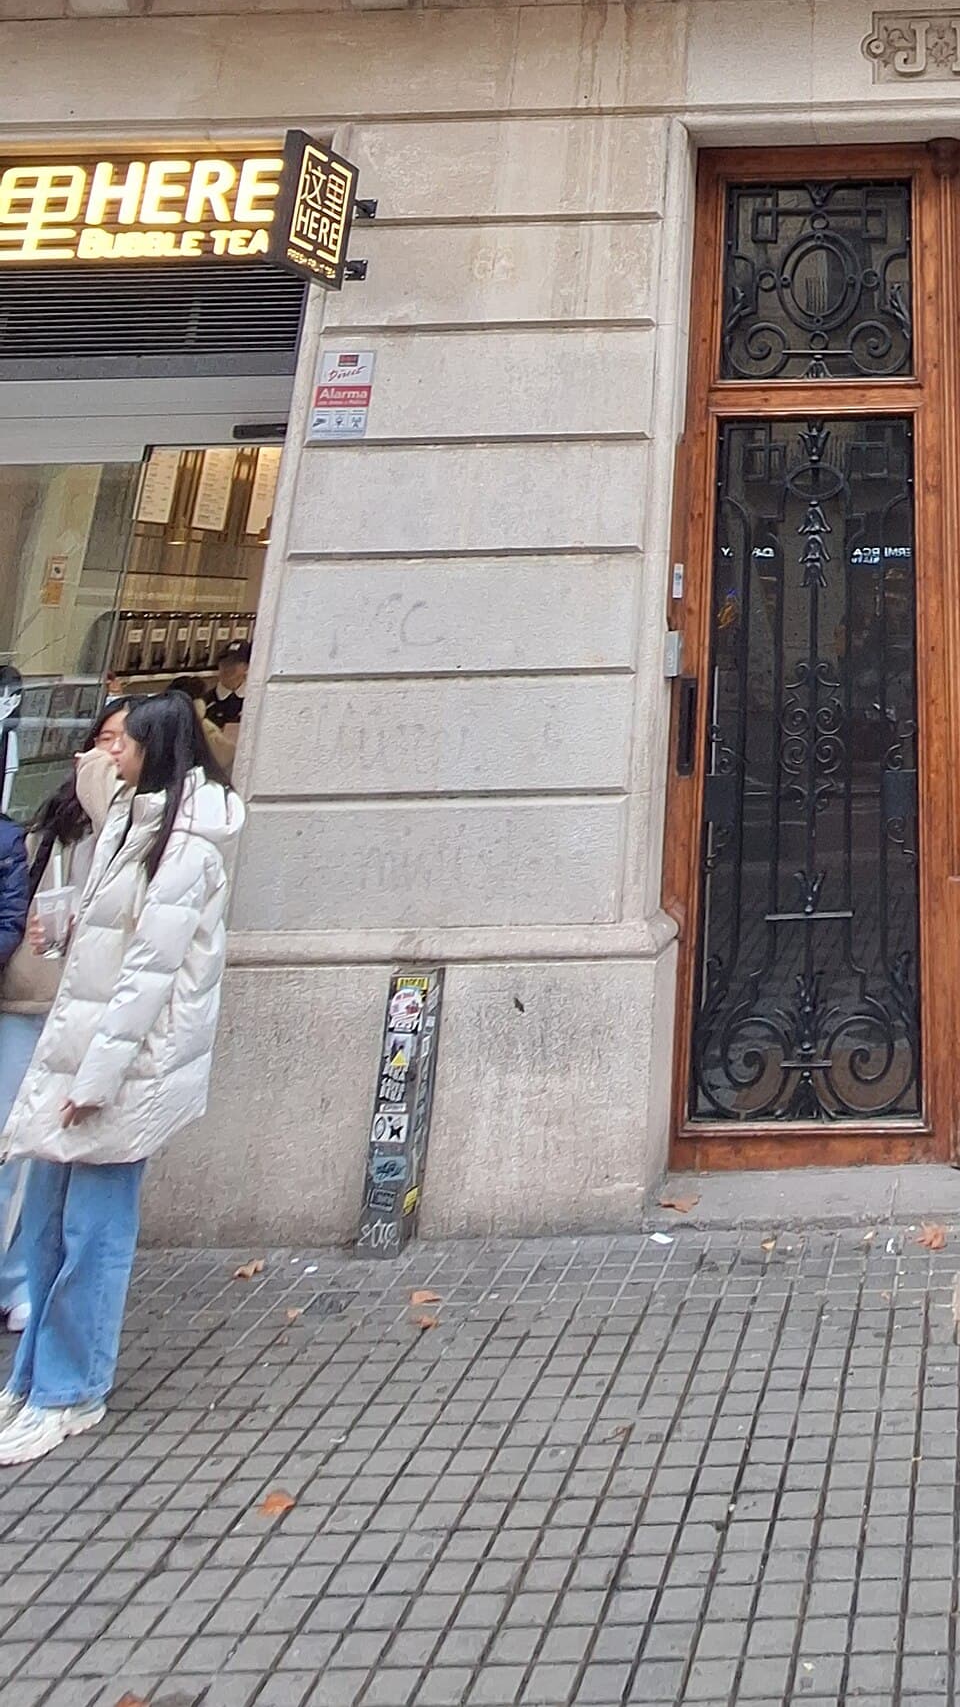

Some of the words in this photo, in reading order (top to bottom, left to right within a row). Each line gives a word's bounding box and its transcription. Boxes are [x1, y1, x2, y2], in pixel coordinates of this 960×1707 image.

[84, 158, 284, 225] HERE
[300, 161, 346, 220] 这里
[210, 229, 269, 256] TEA
[296, 204, 340, 251] HERE
[319, 387, 368, 399] Alarma
